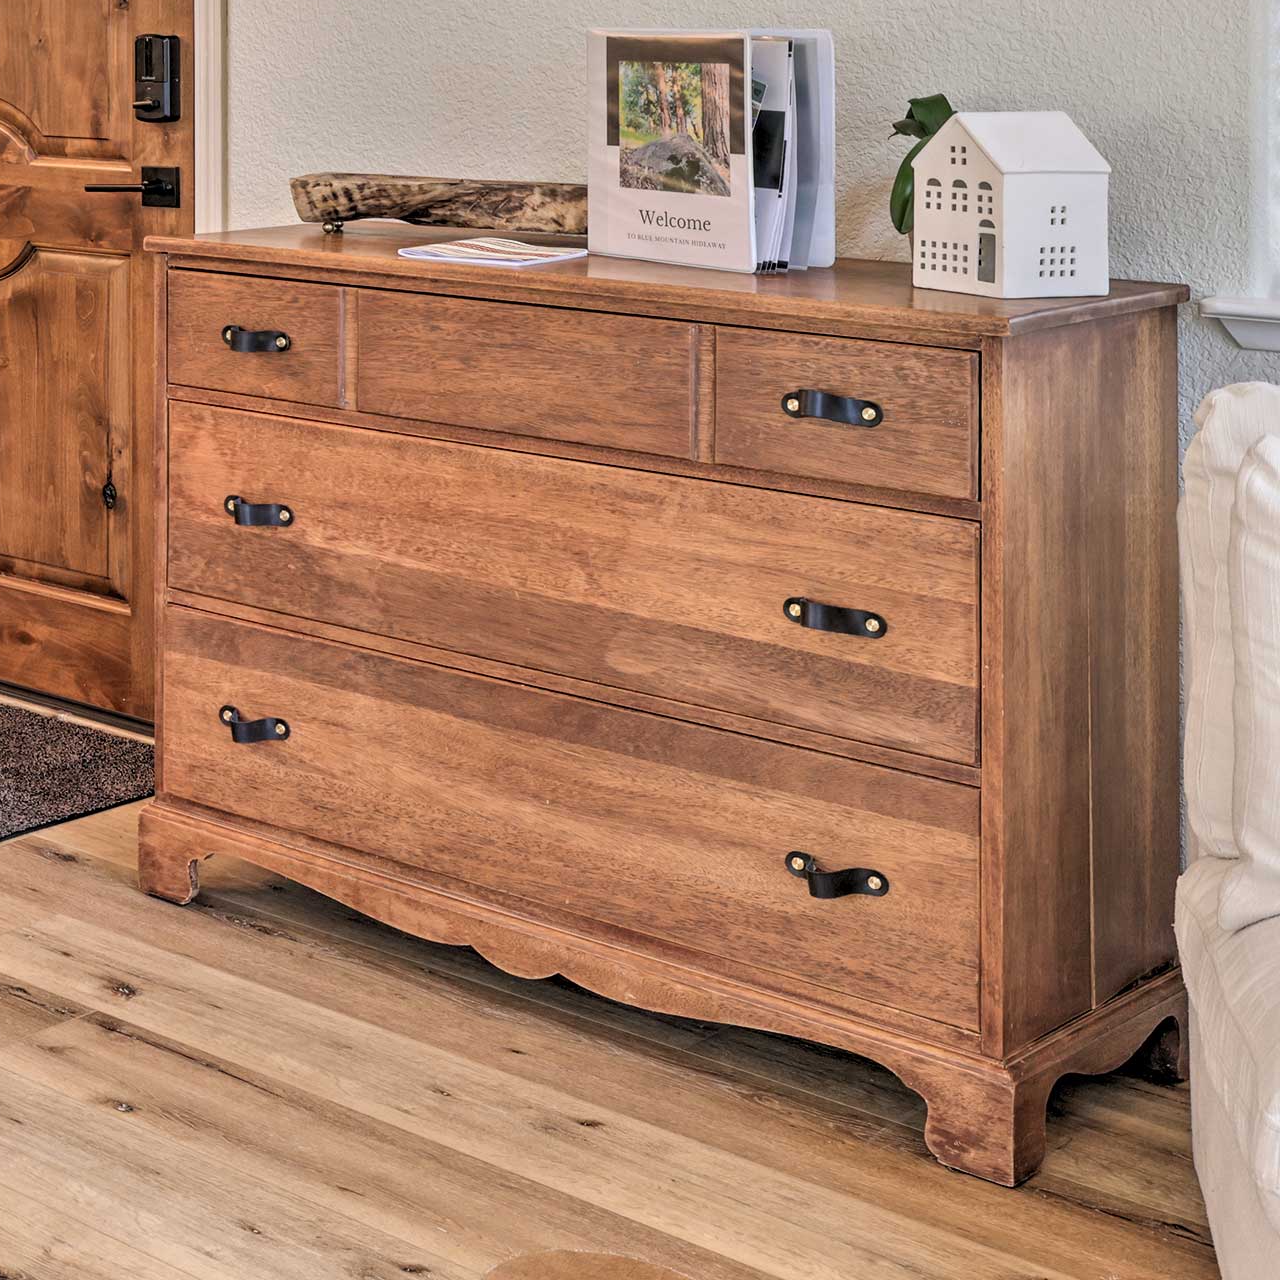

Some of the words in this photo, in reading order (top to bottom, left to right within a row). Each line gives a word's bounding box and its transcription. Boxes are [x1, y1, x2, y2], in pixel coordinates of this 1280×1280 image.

[638, 209, 712, 232] Welcome
[637, 233, 653, 242] BLUE
[654, 235, 690, 245] MOUNTAIN
[691, 239, 726, 250] HIDEAWAY
